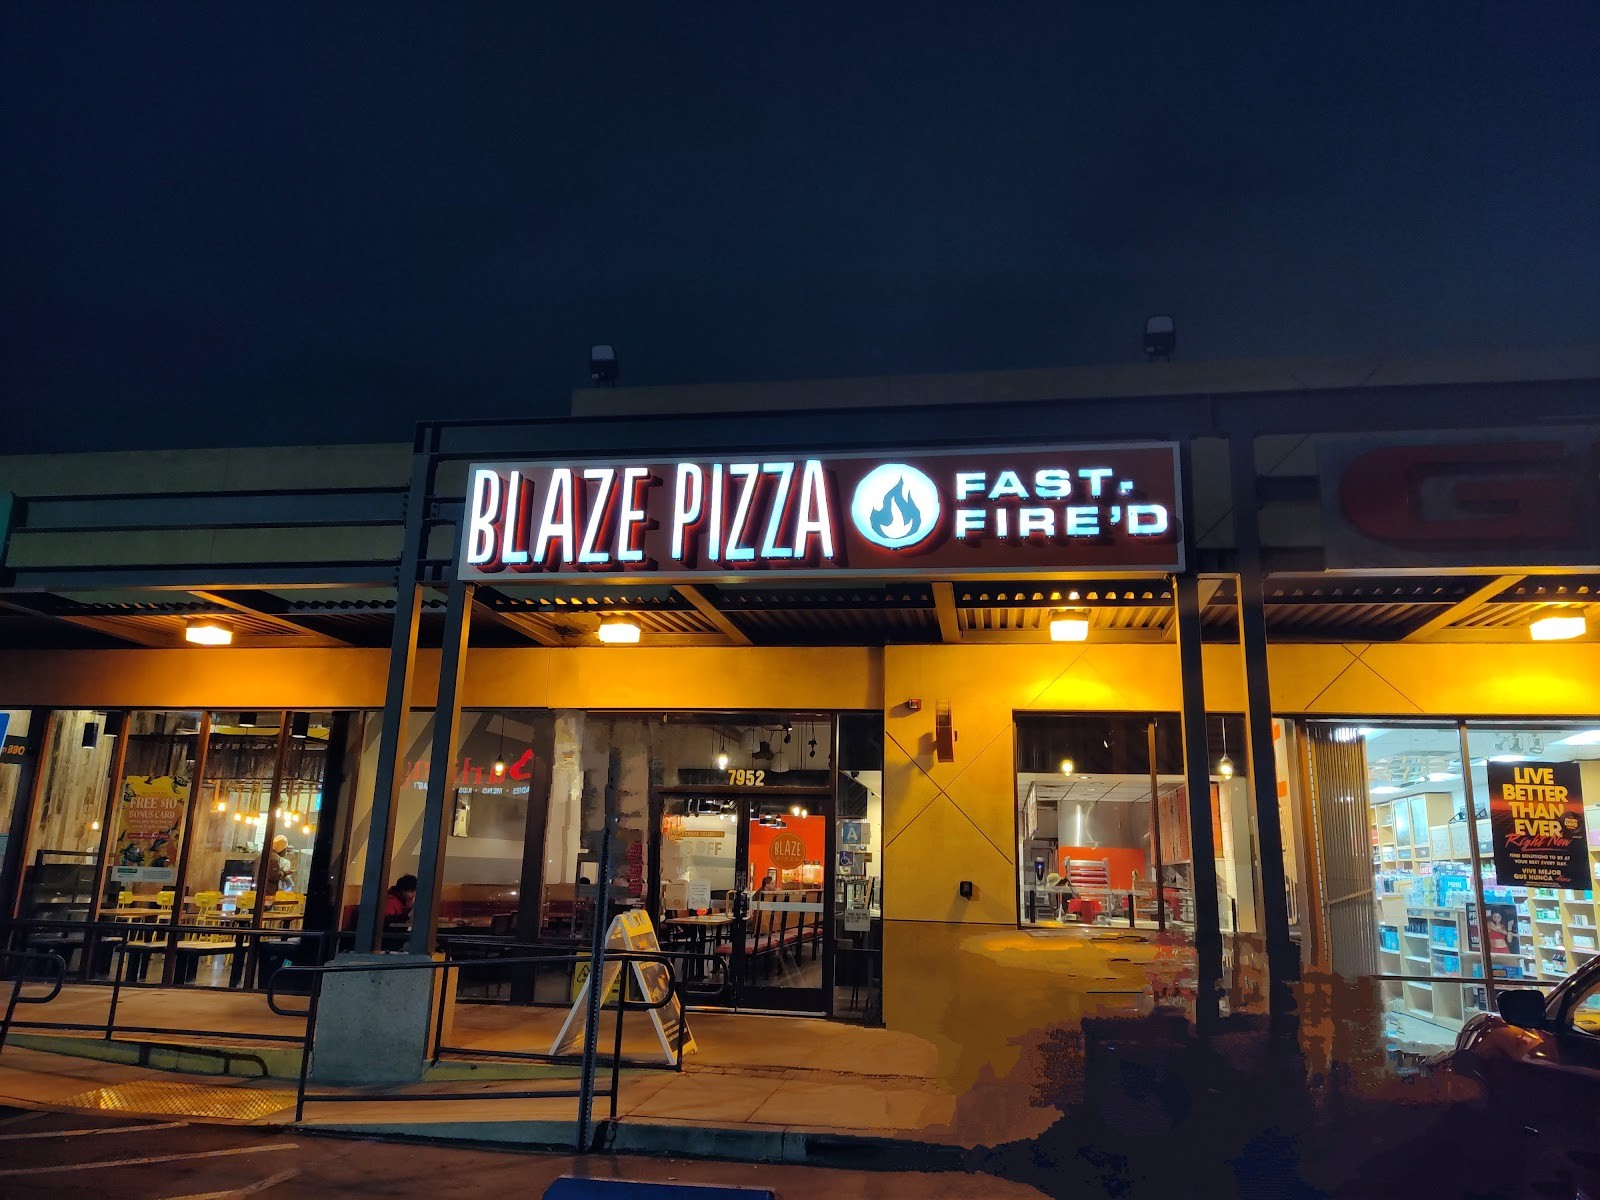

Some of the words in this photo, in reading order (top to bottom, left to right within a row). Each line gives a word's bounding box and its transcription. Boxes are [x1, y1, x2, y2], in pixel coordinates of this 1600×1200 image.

[467, 468, 649, 564] BLAZE
[672, 460, 834, 560] PIZZA
[956, 504, 1169, 538] FIRE'D
[728, 769, 765, 787] 7952
[1514, 767, 1554, 785] LIVE
[1502, 784, 1569, 802] BETTER
[129, 797, 158, 809] FREE
[1509, 802, 1564, 819] THAN
[128, 810, 154, 819] BONUS
[154, 811, 175, 819] CARD
[847, 827, 858, 840] A
[1514, 820, 1563, 838] EVER
[774, 840, 801, 856] BLAZE
[1505, 833, 1544, 849] Right
[1547, 835, 1572, 847] Now
[1528, 874, 1554, 882] NUNCA
[1538, 868, 1562, 876] MEJOR
